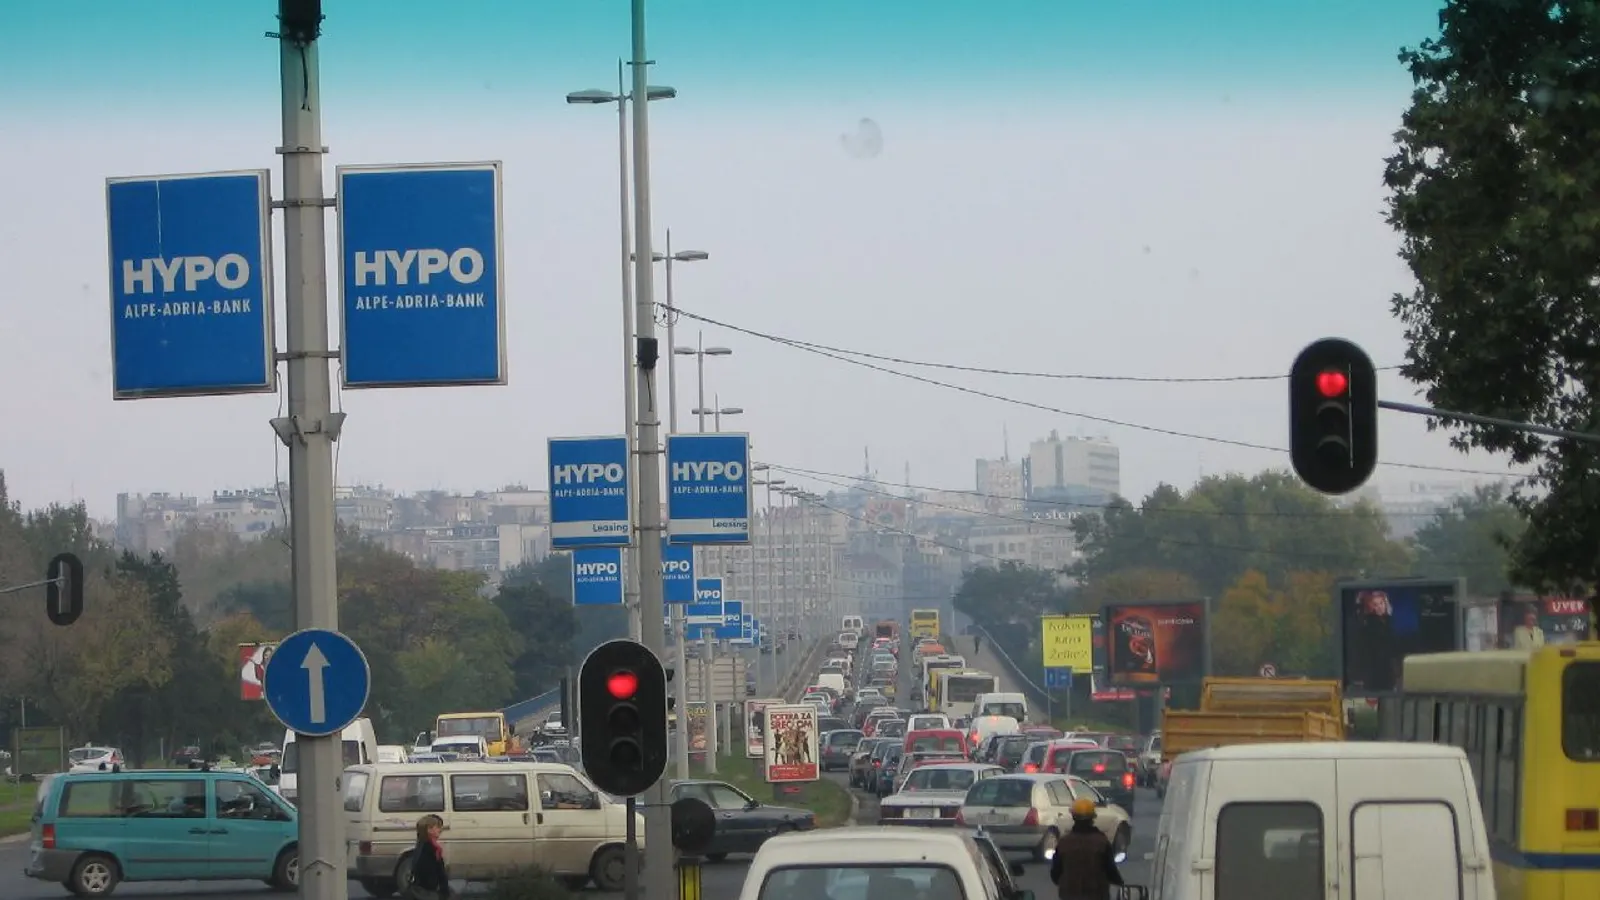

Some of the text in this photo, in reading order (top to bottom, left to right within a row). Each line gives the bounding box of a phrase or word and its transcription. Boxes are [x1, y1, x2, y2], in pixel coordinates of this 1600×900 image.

[122, 253, 250, 295] HYPO
[355, 246, 484, 286] HYPO
[124, 298, 251, 319] ALPE-ADRIA-BANK
[355, 292, 485, 311] ALPE-ADRIA-BANK
[553, 462, 624, 485] HYPO
[672, 460, 744, 482] HYPO
[592, 522, 629, 533] Leasing
[712, 517, 748, 530] Leasing
[576, 562, 618, 575] HYPO
[661, 560, 691, 574] YPO
[697, 590, 721, 600] YPO
[801, 712, 813, 720] ZA
